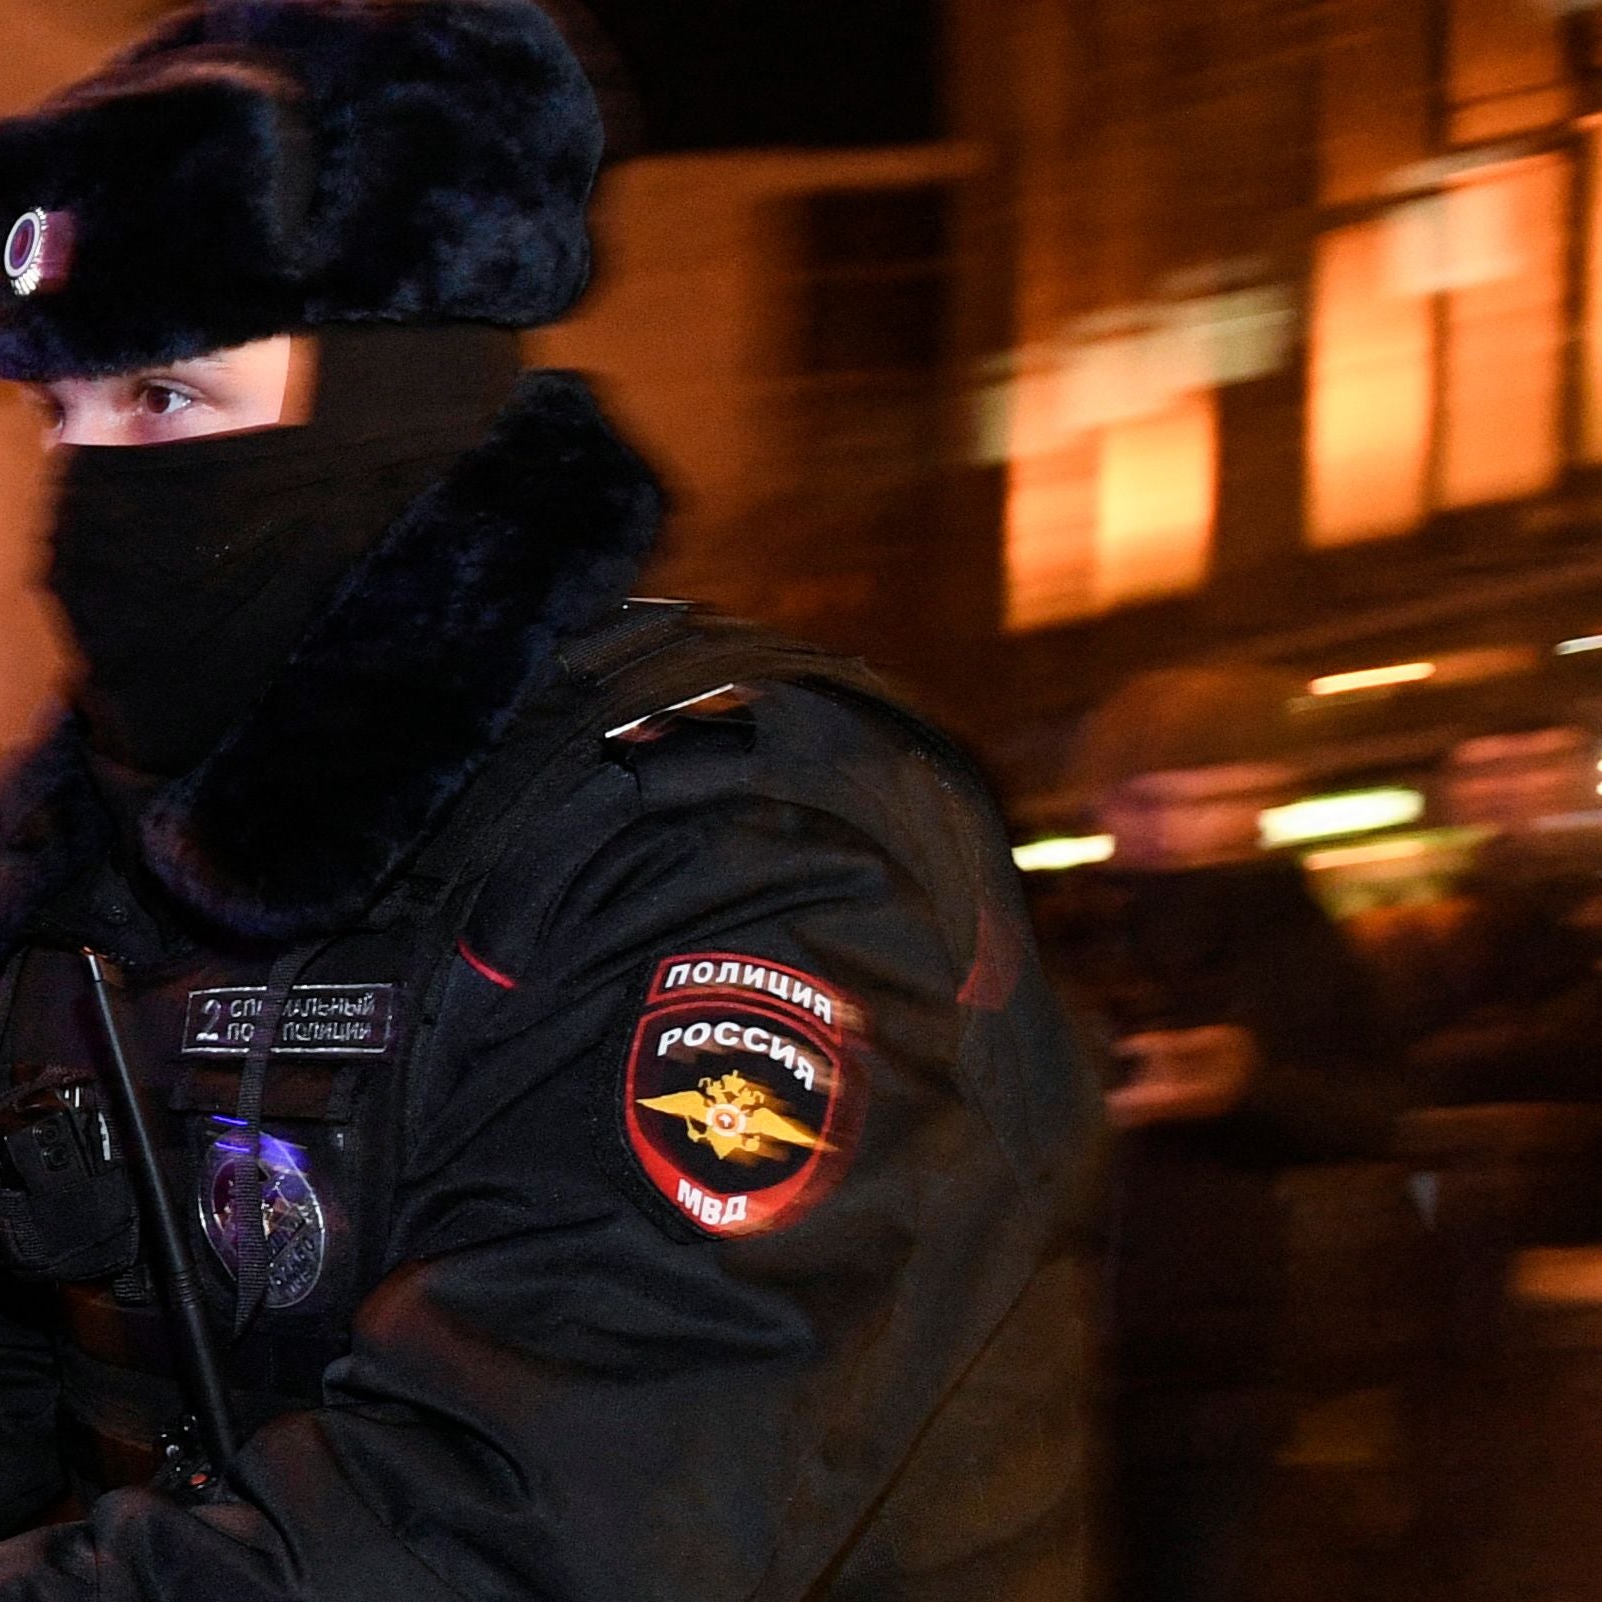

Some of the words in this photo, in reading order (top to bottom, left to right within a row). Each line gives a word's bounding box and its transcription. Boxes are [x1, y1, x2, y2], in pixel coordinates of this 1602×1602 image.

[665, 961, 833, 1024] ПОЛИЦИЯ
[195, 998, 222, 1042] 2
[282, 1021, 373, 1042] ПОЛИЦИИ
[656, 1021, 816, 1091] РОССИЯ
[676, 1178, 748, 1226] МВД
